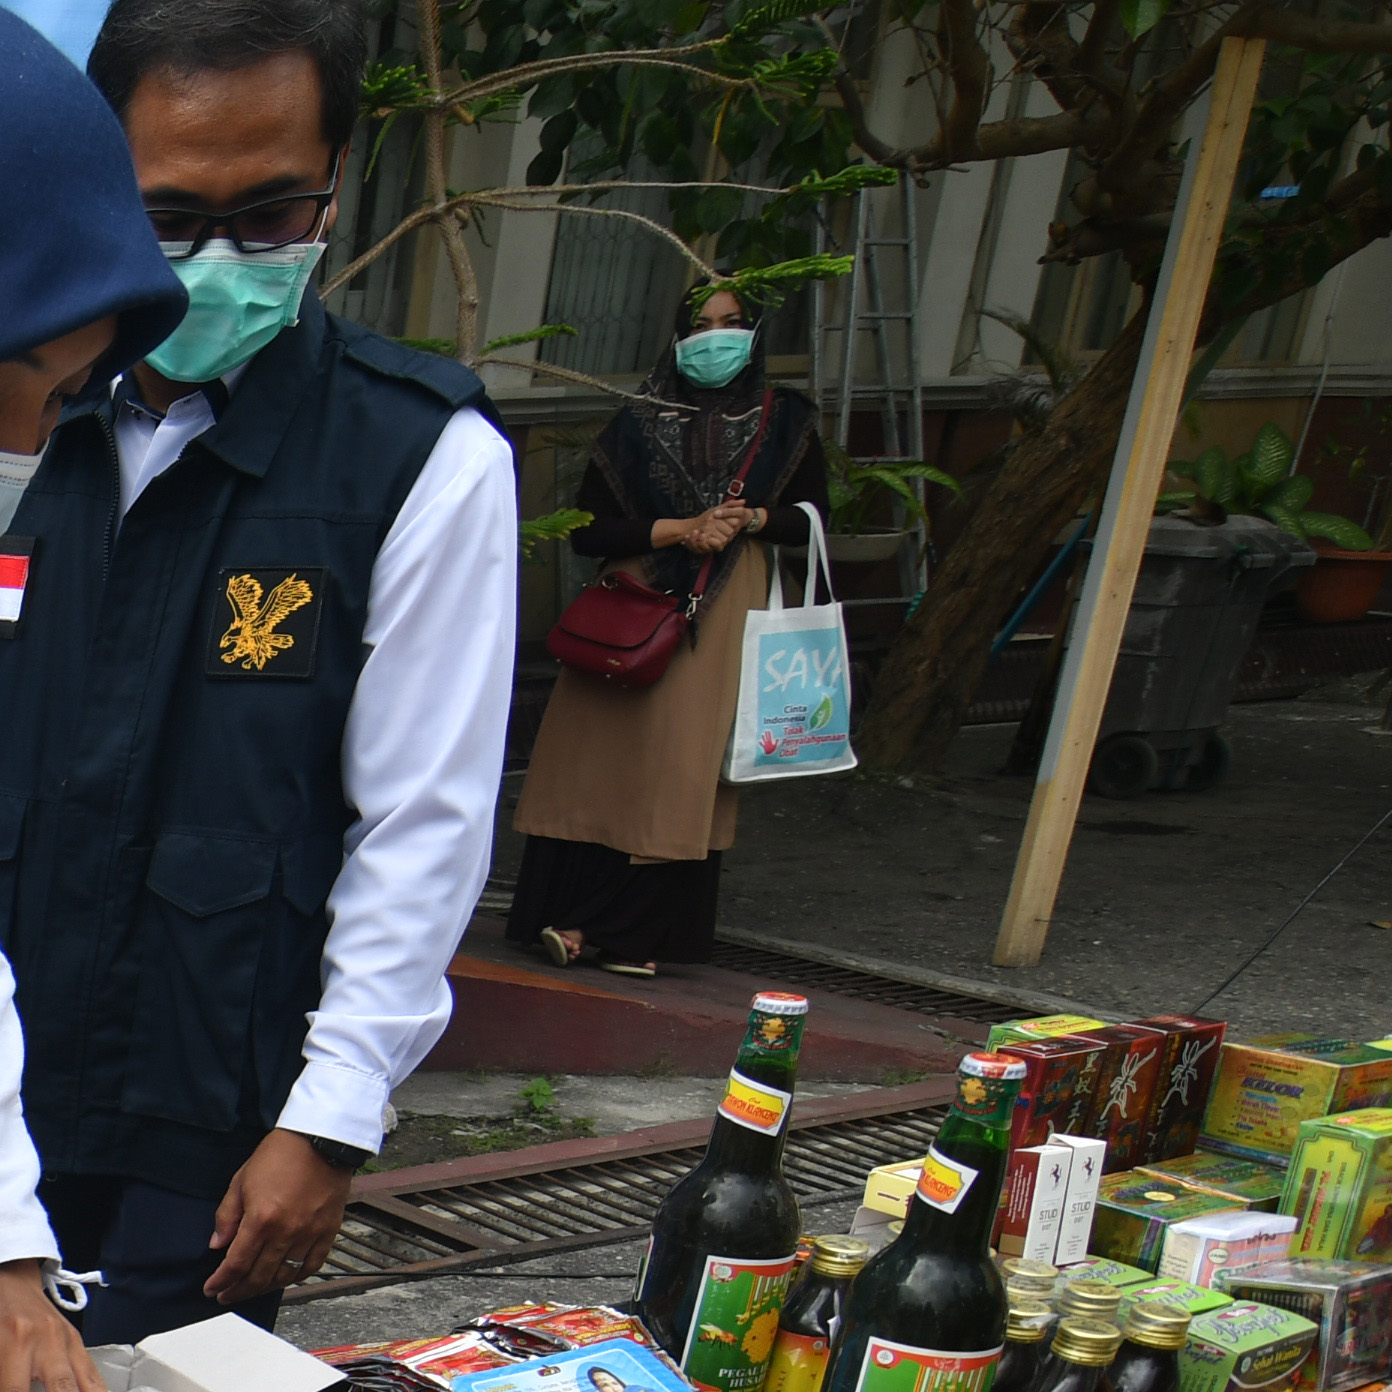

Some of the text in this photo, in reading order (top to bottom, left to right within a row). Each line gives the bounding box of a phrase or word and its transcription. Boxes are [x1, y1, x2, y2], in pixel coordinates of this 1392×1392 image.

[783, 705, 807, 714] Cinta
[763, 715, 806, 725] Indonesia
[778, 748, 798, 758] Obat
[1241, 1076, 1304, 1099] KELOR
[1071, 1201, 1091, 1214] STUD
[1039, 1208, 1058, 1222] STUD
